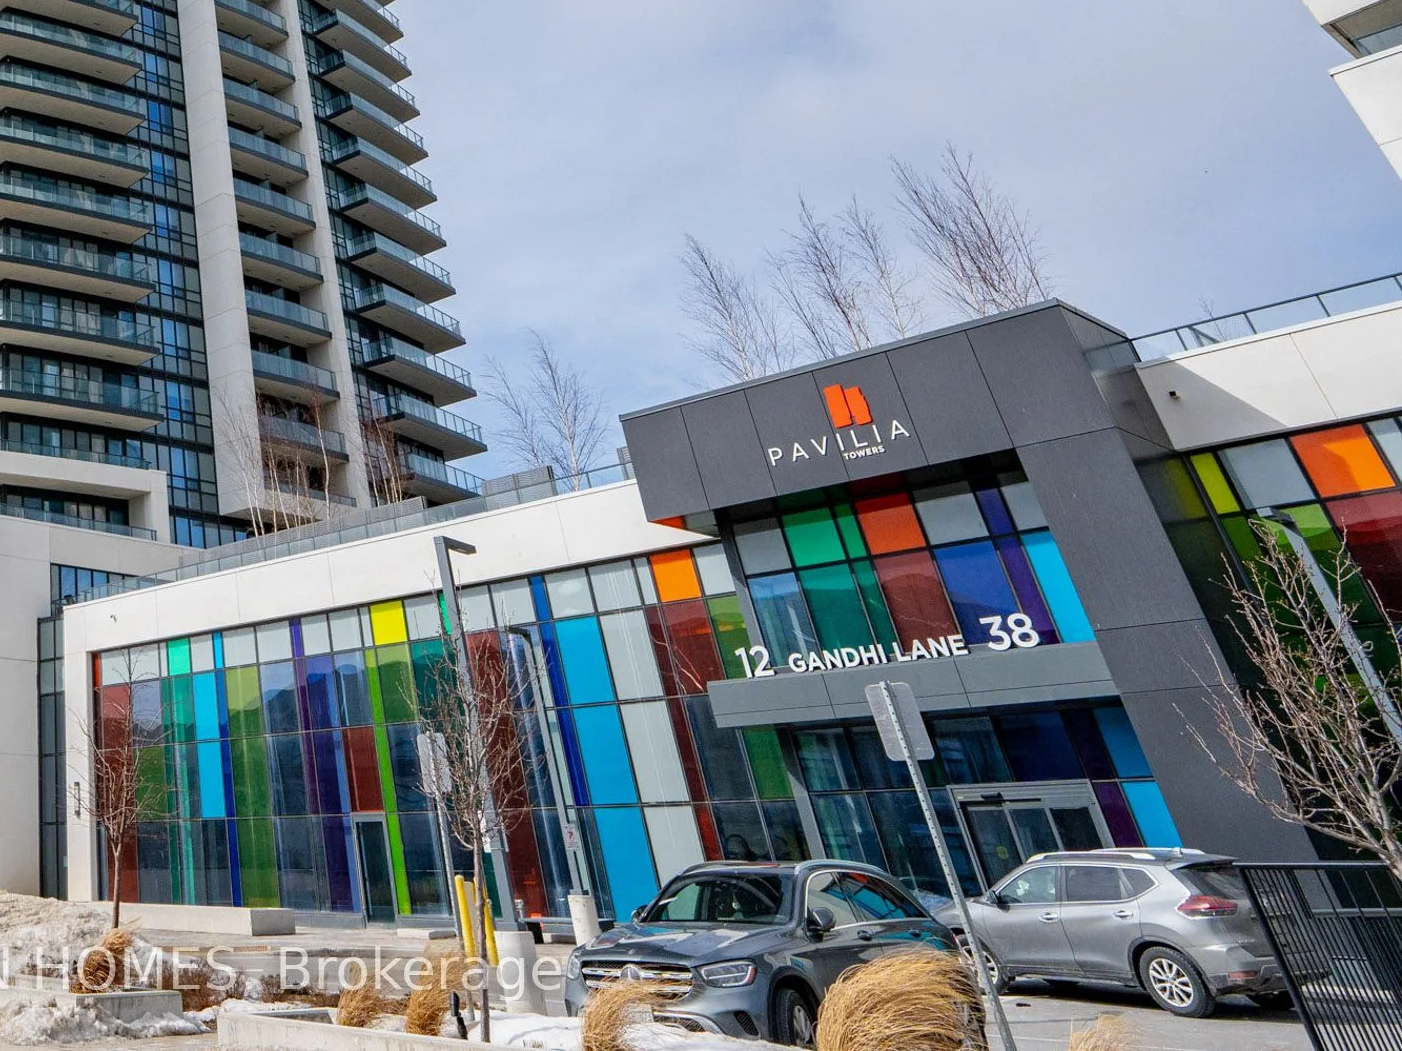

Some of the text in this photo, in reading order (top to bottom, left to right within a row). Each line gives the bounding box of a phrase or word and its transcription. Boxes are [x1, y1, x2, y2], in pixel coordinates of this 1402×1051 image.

[767, 419, 910, 466] PAVILIA
[843, 444, 886, 460] TOWERS
[734, 613, 1041, 678] 12 GANDHI LANE 38
